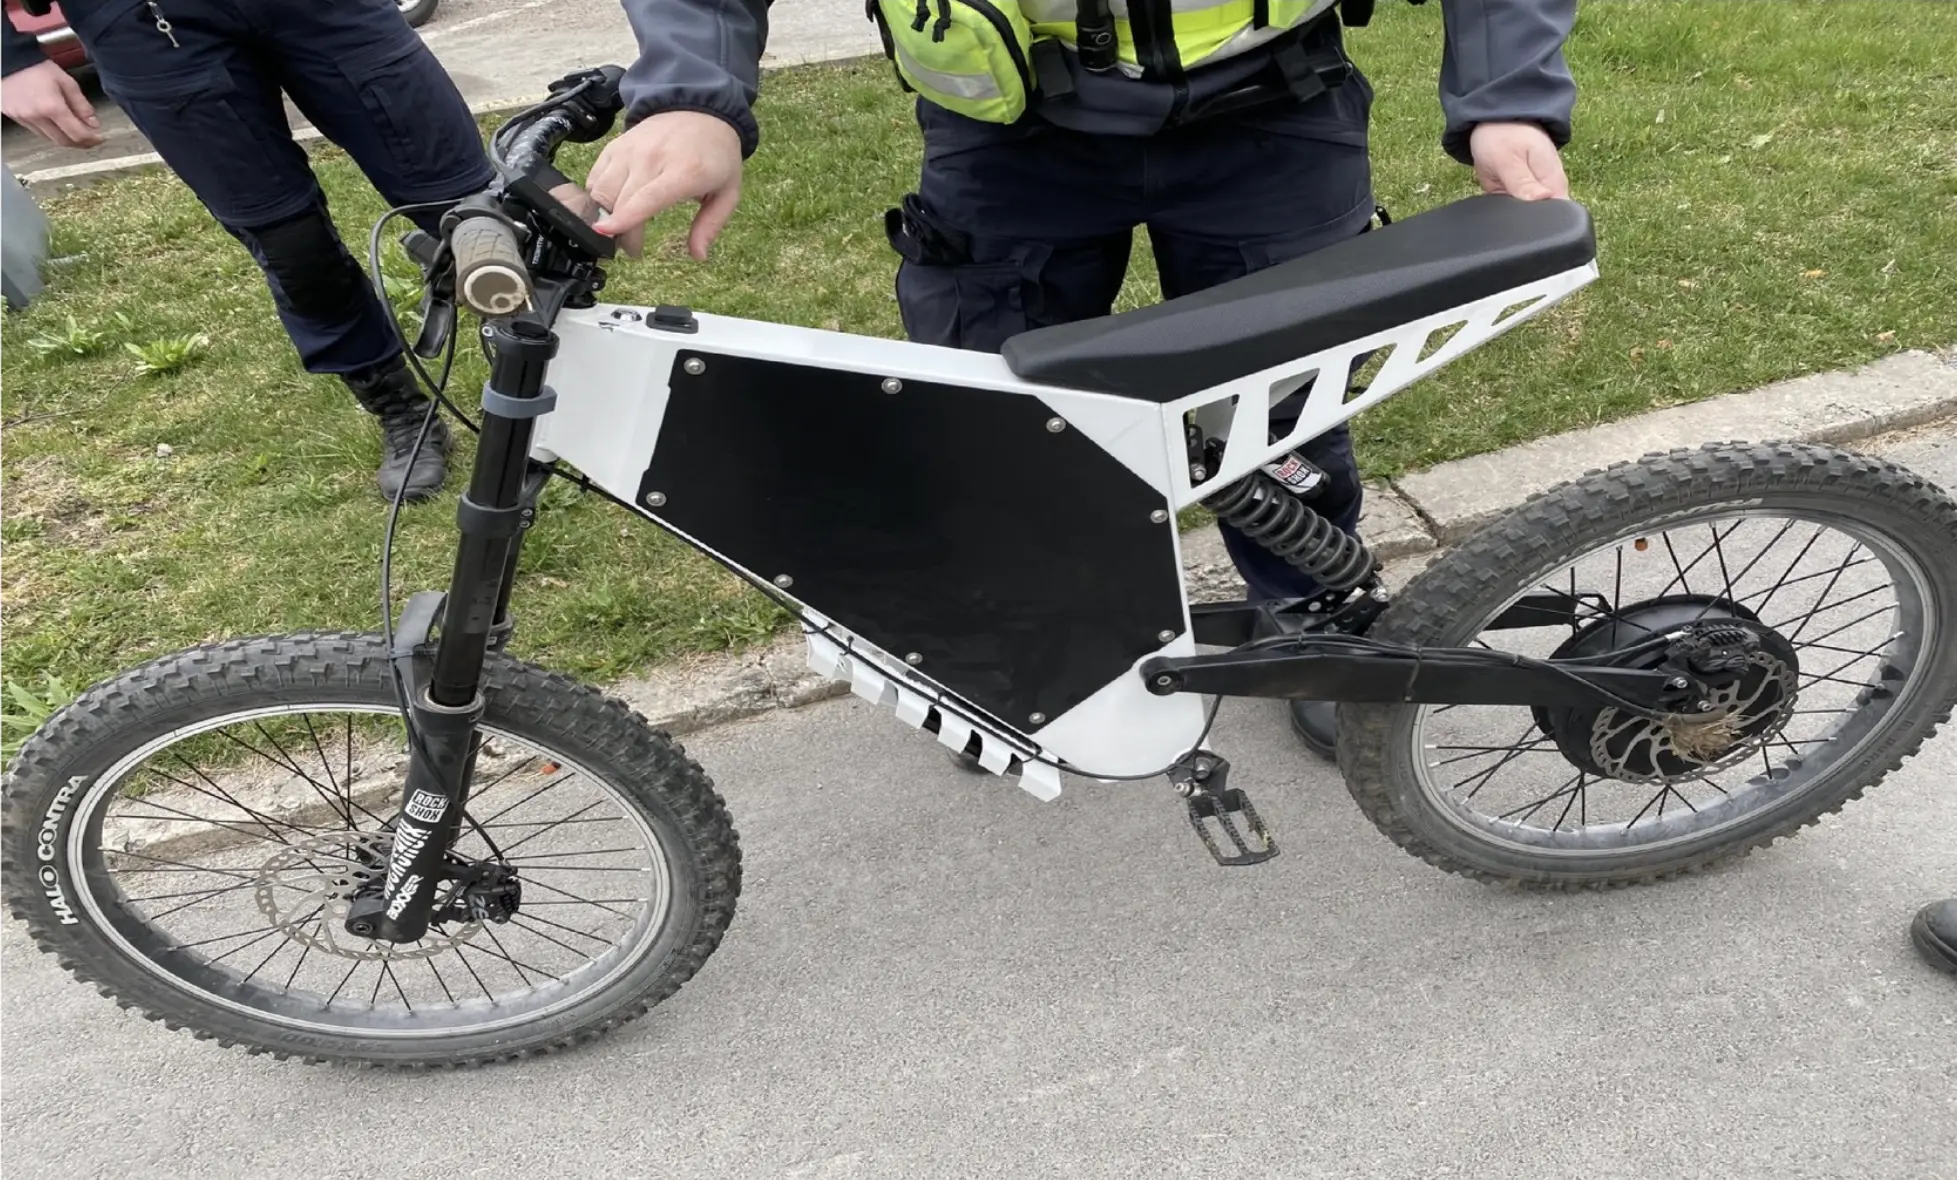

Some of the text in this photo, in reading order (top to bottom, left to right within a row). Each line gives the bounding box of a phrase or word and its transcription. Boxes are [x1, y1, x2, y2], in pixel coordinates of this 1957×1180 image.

[1277, 460, 1299, 477] ROCK
[1286, 466, 1310, 485] SHOX
[413, 792, 449, 810] ROCK
[409, 804, 440, 821] SHOX
[37, 775, 88, 925] HALO CONTRA
[386, 874, 424, 921] BOXXER
